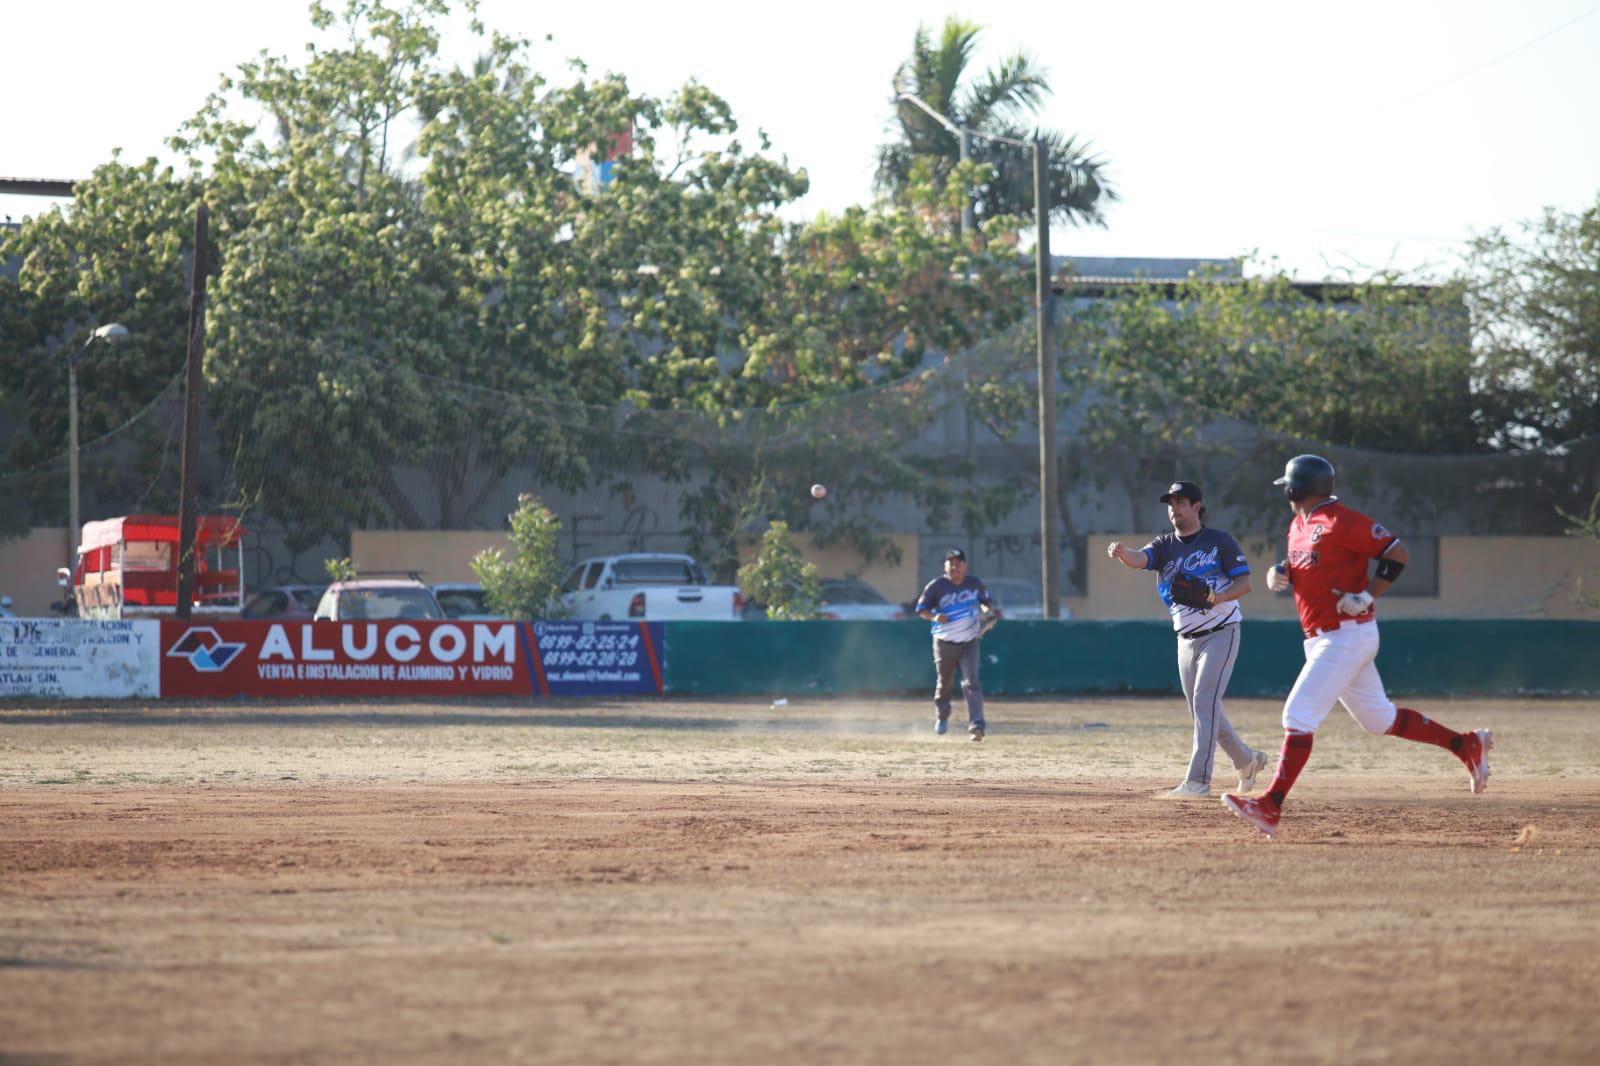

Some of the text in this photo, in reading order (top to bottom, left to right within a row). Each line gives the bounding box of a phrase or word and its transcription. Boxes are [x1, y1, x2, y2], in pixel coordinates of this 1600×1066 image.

[258, 623, 516, 663] ALUCOM
[257, 664, 514, 681] VENTA E INSTALACION DE ALUMINIO Y VIDRIO
